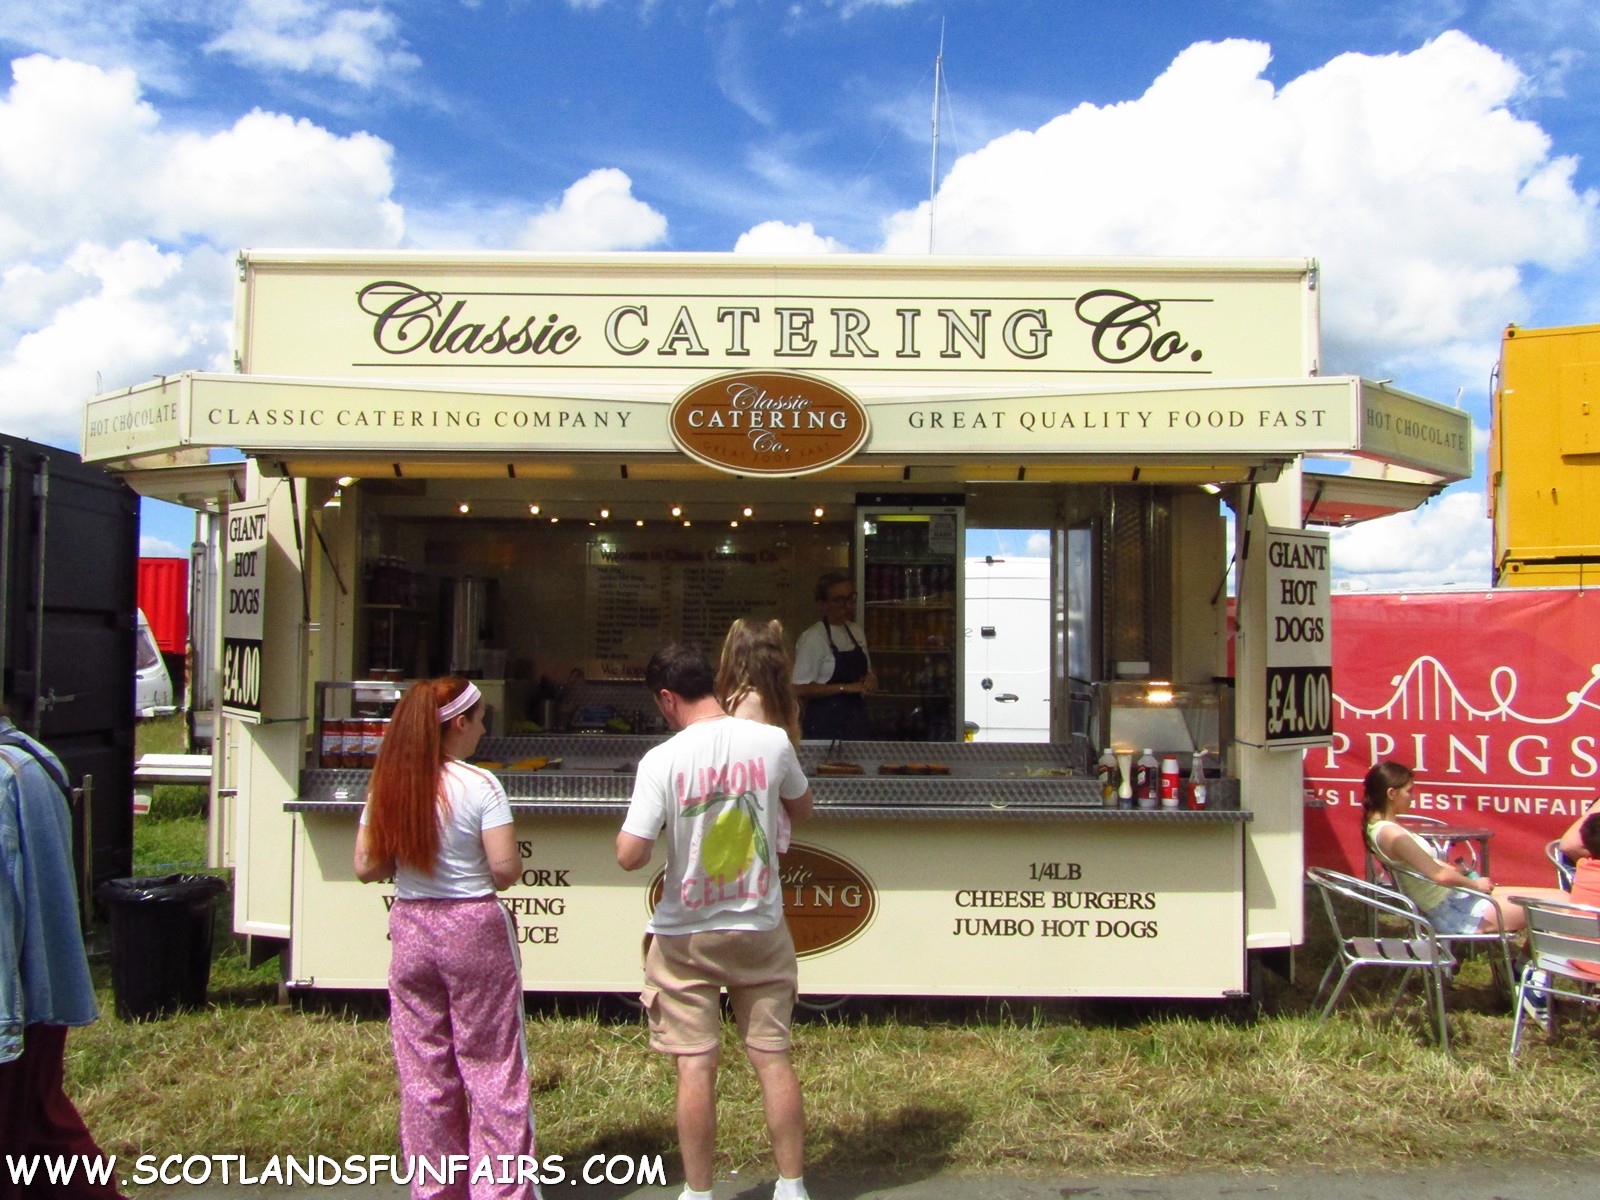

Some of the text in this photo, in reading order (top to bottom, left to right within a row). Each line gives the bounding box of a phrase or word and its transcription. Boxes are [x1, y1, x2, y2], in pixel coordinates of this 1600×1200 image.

[357, 280, 1204, 364] Classic CATERING Co.
[726, 382, 812, 411] Classic
[90, 402, 177, 437] HOT CHOCOLATE
[208, 408, 632, 429] CLASSIC CATERING COMPANY
[688, 410, 847, 430] CATERING
[908, 409, 1328, 432] GREAT QUALITY FOOD FAST
[1366, 408, 1464, 451] HOT CHOCOLATE
[748, 428, 790, 453] Co.
[229, 513, 266, 542] GIANT
[233, 552, 258, 578] HOT
[1268, 541, 1327, 571] GIANT
[229, 588, 260, 615] DOGS
[1280, 579, 1317, 606] HOT
[1275, 616, 1324, 643] DOGS
[223, 644, 261, 706] £4.00
[1268, 672, 1330, 735] £4.00
[677, 756, 767, 806] LIMON
[512, 869, 571, 887] ORK
[1029, 862, 1082, 881] 1/4LB
[681, 866, 771, 909] CELLO
[955, 890, 1156, 910] CHEESE BURGERS
[952, 917, 1158, 939] JUMBO HOT DOGS
